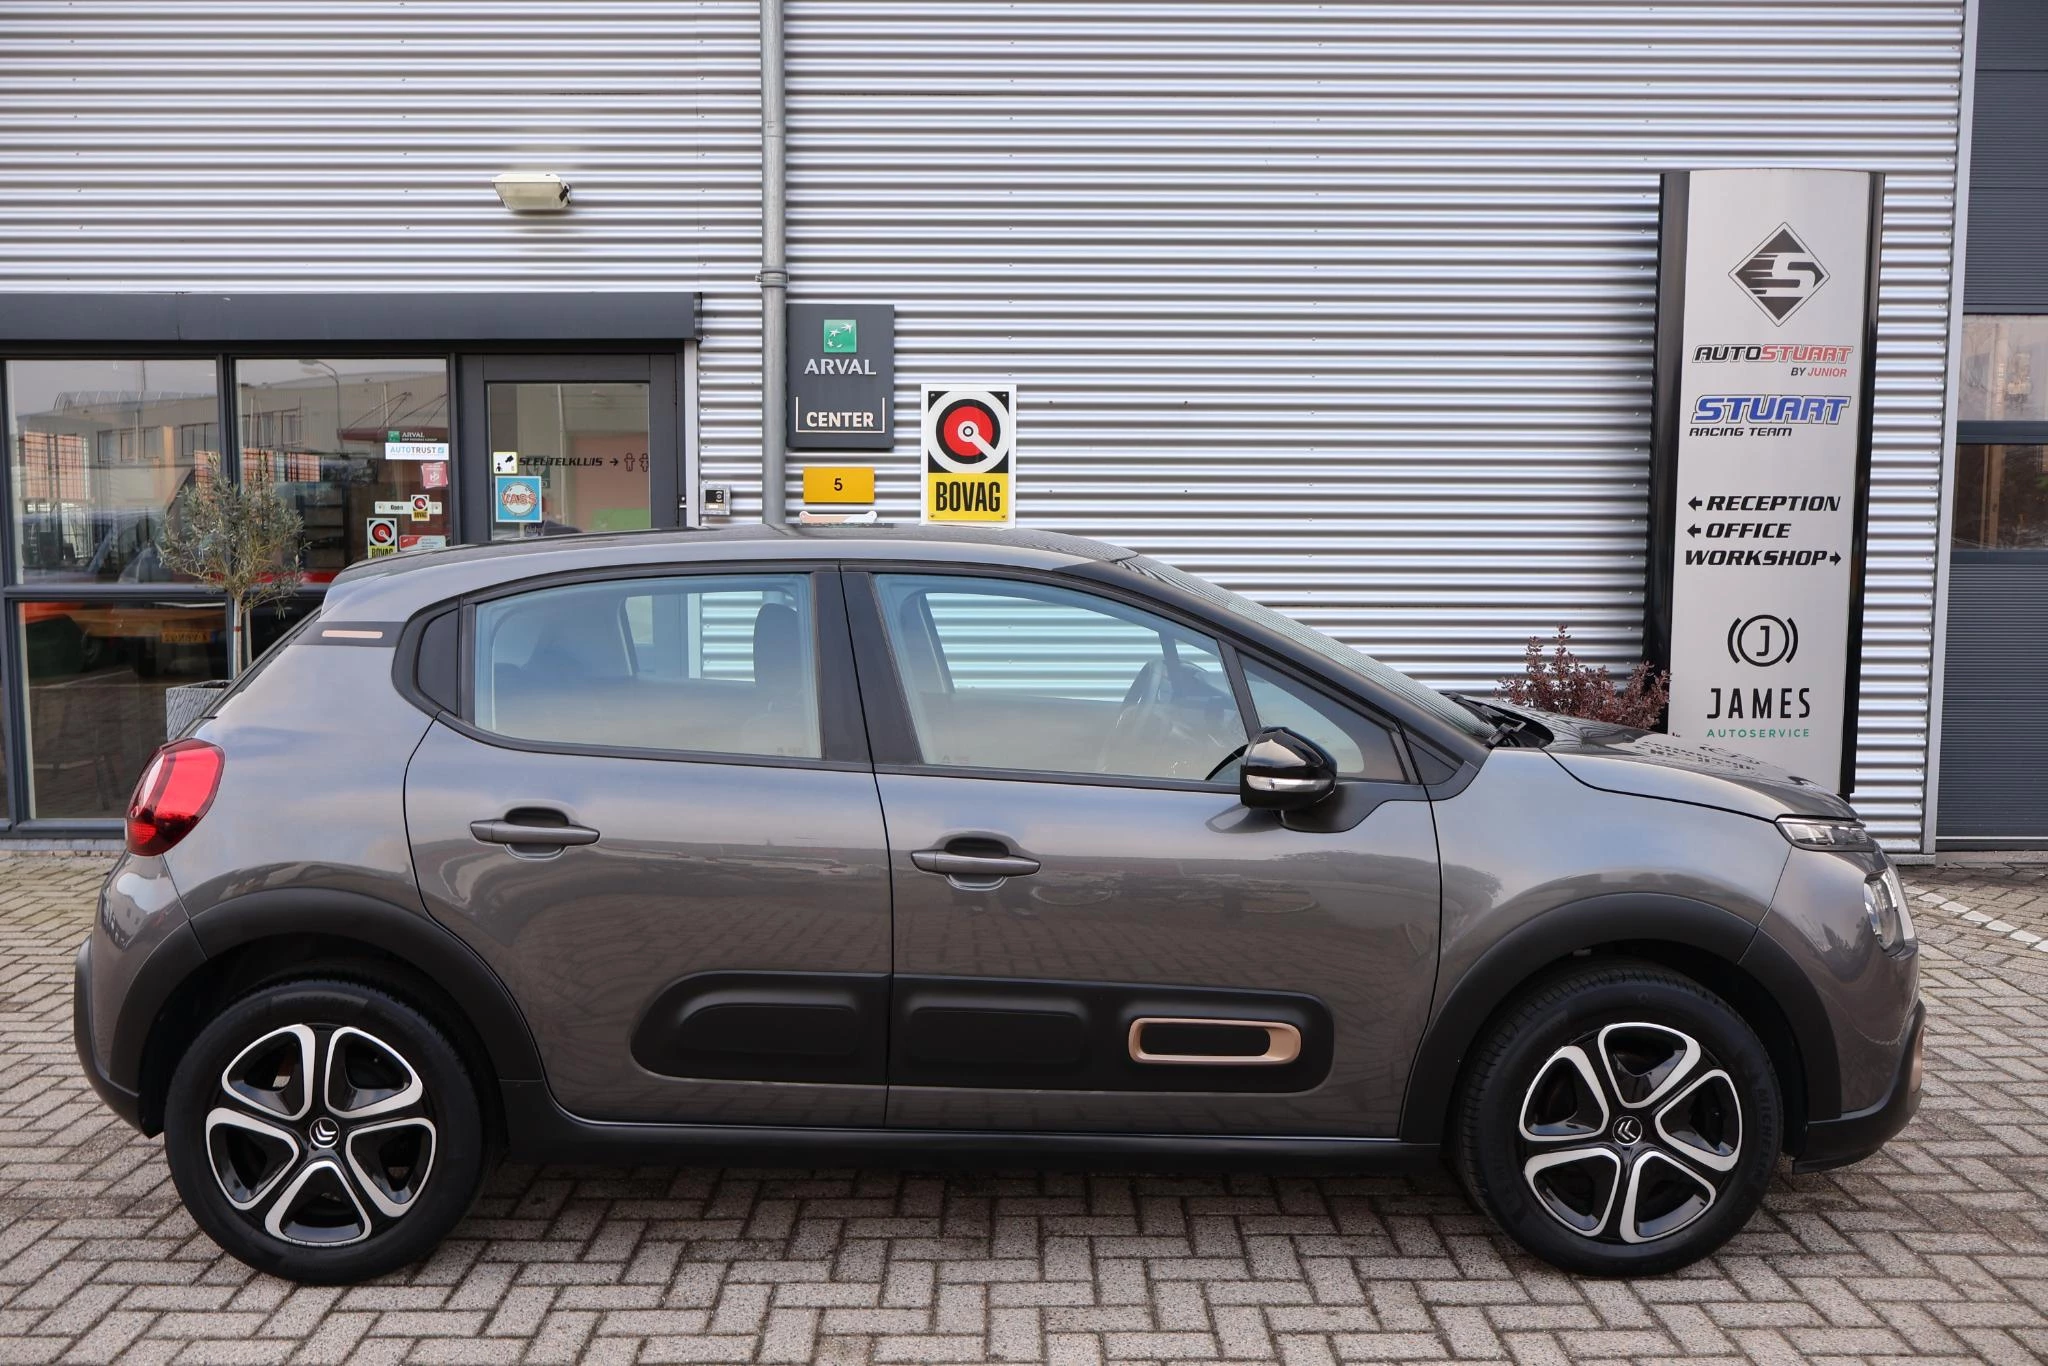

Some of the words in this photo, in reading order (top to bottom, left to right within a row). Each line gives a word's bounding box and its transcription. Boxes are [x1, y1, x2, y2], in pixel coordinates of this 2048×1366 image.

[1691, 343, 1853, 363] AUTOSTUART
[803, 358, 877, 376] ARVAL
[1790, 367, 1806, 377] BY
[1807, 367, 1848, 377] JUNIOR
[1690, 394, 1852, 424] STUART
[806, 411, 875, 428] CENTER
[1688, 427, 1744, 437] RACING
[1748, 427, 1793, 437] TEAM
[833, 477, 843, 491] 5
[935, 481, 1001, 512] BOVAG
[1706, 495, 1841, 512] RECEPTION
[1705, 523, 1792, 539] OFFICE
[1685, 550, 1828, 566] WORKSHOP
[1706, 687, 1811, 719] JAMES
[1706, 728, 1810, 738] AUTOSERVICE
